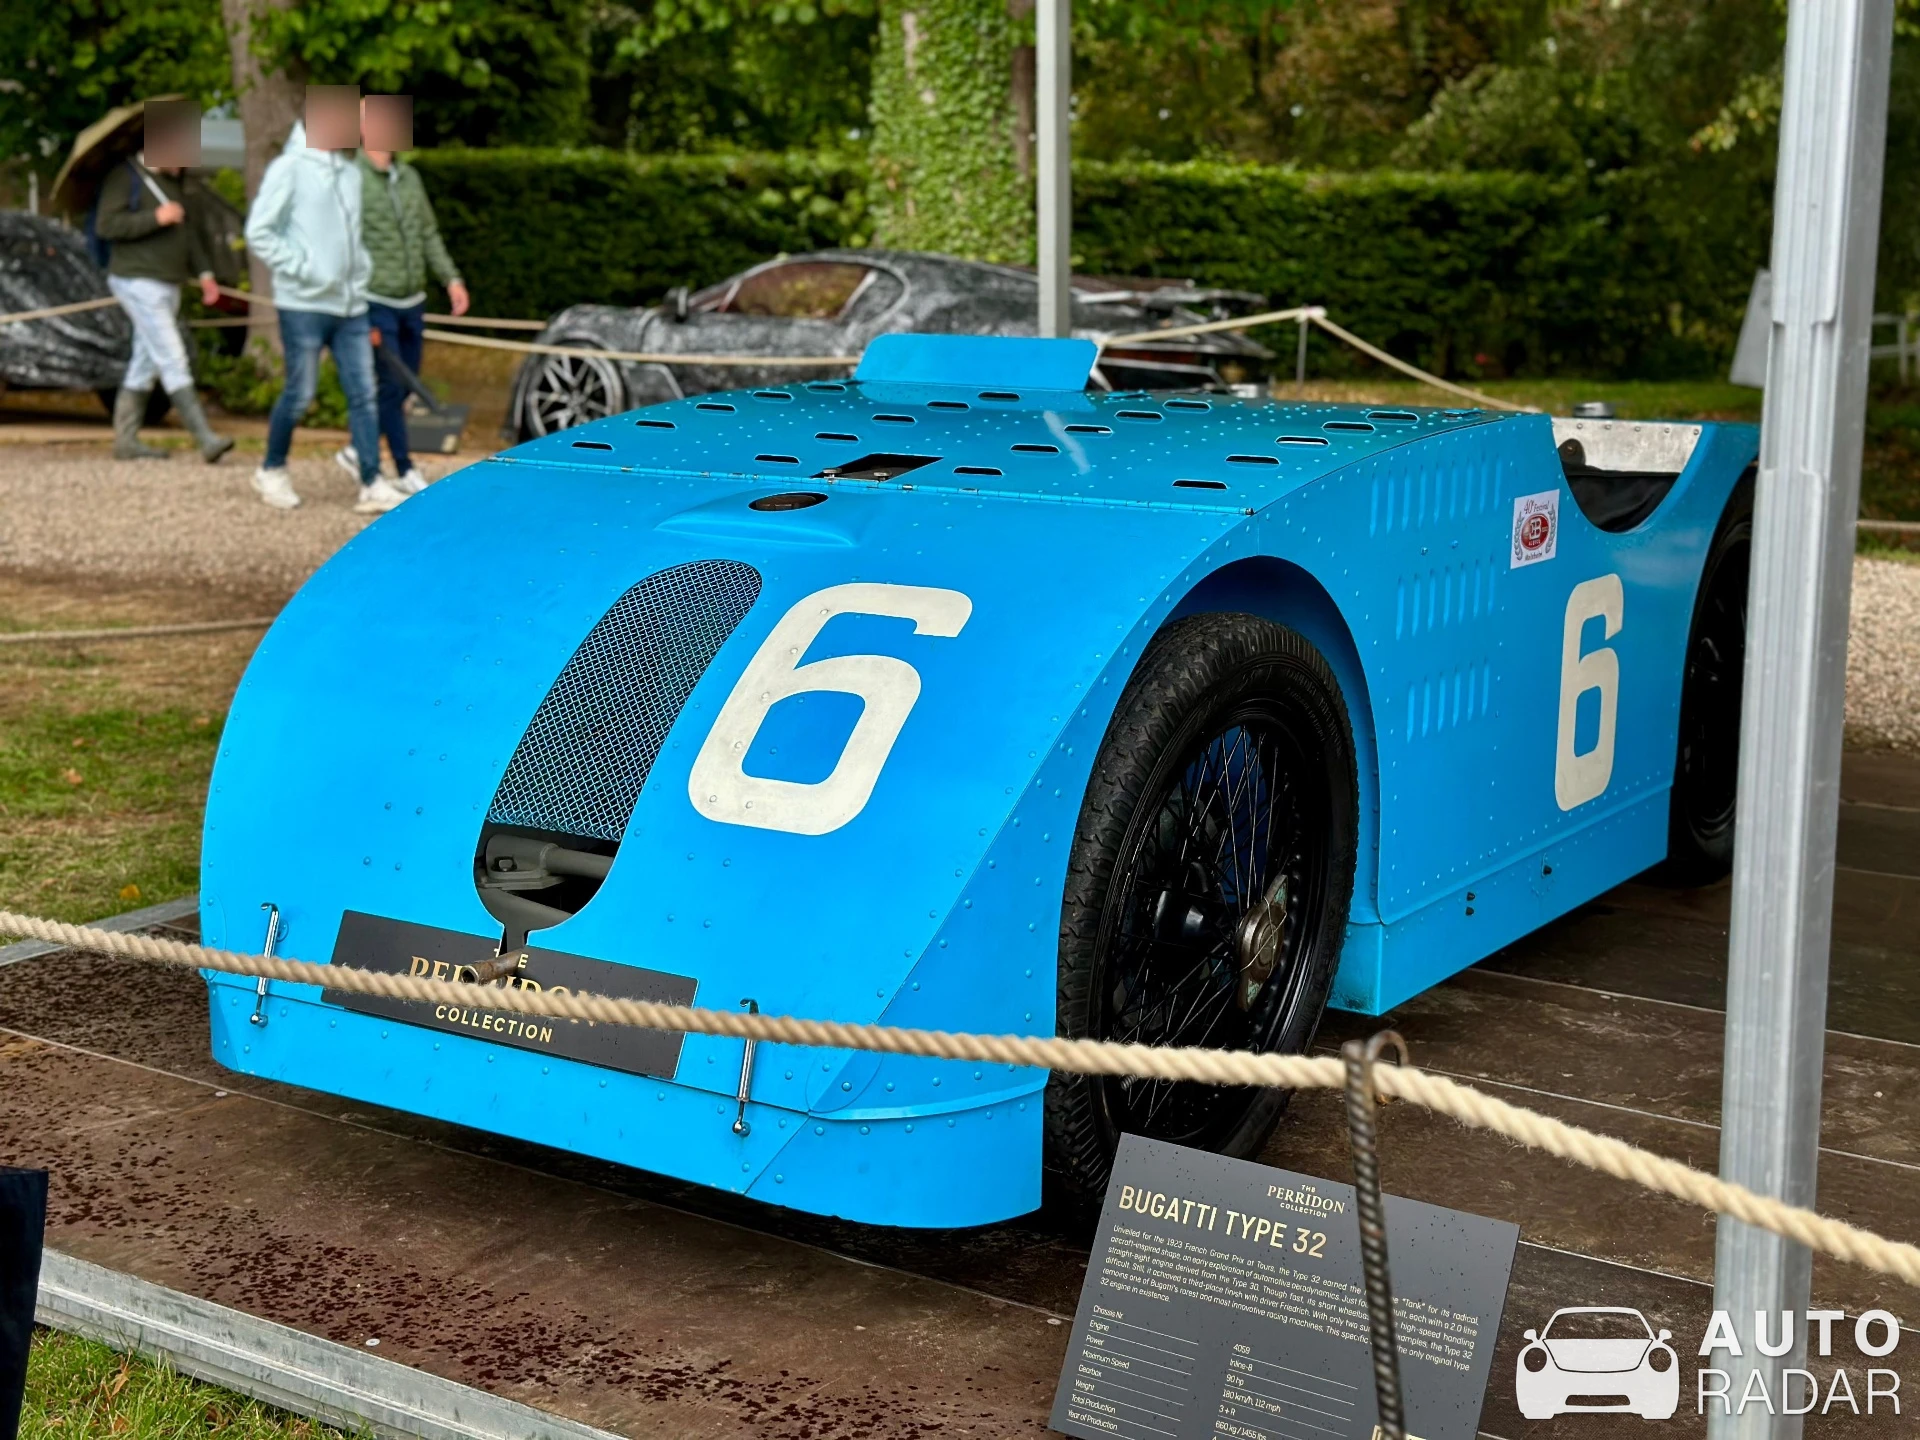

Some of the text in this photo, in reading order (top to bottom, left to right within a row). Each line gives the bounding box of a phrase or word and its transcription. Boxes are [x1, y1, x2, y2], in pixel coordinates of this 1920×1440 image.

[1555, 573, 1624, 811] 6
[688, 582, 973, 836] 6
[494, 948, 529, 969] TE
[435, 1005, 553, 1043] COLLECTION
[1301, 1184, 1316, 1193] THE
[1267, 1185, 1346, 1214] PERRIDON
[1280, 1202, 1327, 1219] COLLECTION
[1118, 1185, 1327, 1258] BUGATTI TYPE 32
[1114, 1225, 1140, 1238] Unveiled
[1143, 1232, 1152, 1240] for
[1154, 1235, 1164, 1243] the
[1167, 1238, 1183, 1248] 1923
[1185, 1243, 1208, 1254] French
[1210, 1249, 1229, 1260] Grand
[1232, 1255, 1244, 1264] Prix
[1279, 1267, 1290, 1276] the
[1293, 1270, 1308, 1281] Type
[1311, 1275, 1320, 1283] 32
[1323, 1280, 1347, 1290] earned
[1350, 1286, 1361, 1295] the
[1428, 1305, 1438, 1314] for
[1441, 1308, 1450, 1317] its
[1100, 1277, 1109, 1286] 32
[1110, 1279, 1131, 1291] engine
[1132, 1286, 1138, 1294] in
[1108, 1247, 1150, 1262] straight-eight
[1152, 1258, 1173, 1269] engine
[1176, 1264, 1199, 1276] derived
[1201, 1270, 1216, 1280] from
[1219, 1275, 1230, 1283] the
[1232, 1277, 1247, 1288] Type
[1263, 1286, 1287, 1299] Though
[1307, 1298, 1316, 1306] its
[1318, 1301, 1336, 1311] short
[1401, 1322, 1441, 1339] high-speed
[1443, 1333, 1475, 1350] handling
[1209, 1262, 1245, 1275] exploration
[1254, 1272, 1290, 1288] automotive
[1342, 1295, 1357, 1305] Just
[1409, 1313, 1426, 1324] each
[1428, 1317, 1443, 1327] with
[1463, 1328, 1477, 1336] litre
[1093, 1305, 1115, 1318] Chassis
[1103, 1268, 1128, 1279] remains
[1180, 1288, 1198, 1298] rarest
[1200, 1293, 1212, 1302] and
[1214, 1297, 1231, 1307] most
[1231, 1302, 1265, 1316] innovative
[1267, 1311, 1287, 1324] racing
[1326, 1326, 1340, 1336] This
[1341, 1331, 1368, 1344] specific
[1409, 1349, 1425, 1360] only
[1426, 1354, 1452, 1367] original
[1454, 1360, 1469, 1371] type
[1153, 1269, 1181, 1282] achieved
[1189, 1278, 1223, 1294] third-place
[1225, 1287, 1242, 1298] finish
[1245, 1292, 1258, 1302] with
[1260, 1297, 1279, 1308] driver
[1313, 1310, 1327, 1320] With
[1330, 1316, 1344, 1326] only
[1345, 1321, 1357, 1329] two
[1430, 1342, 1442, 1352] the
[1444, 1345, 1460, 1357] Type
[1462, 1350, 1472, 1360] 32
[1090, 1320, 1109, 1332] Engine
[1086, 1335, 1104, 1346] Power
[1233, 1344, 1250, 1354] 4059
[1079, 1364, 1102, 1377] Gearbox
[1111, 1357, 1130, 1369] Speed
[1230, 1359, 1253, 1371] Inline-8
[1076, 1379, 1094, 1391] Weight
[1226, 1374, 1244, 1386] 90 hp
[1072, 1394, 1116, 1414] Total Production
[1219, 1405, 1224, 1413] 3
[1230, 1408, 1236, 1416] R
[1223, 1389, 1234, 1399] 180
[1255, 1399, 1265, 1409] 112
[1266, 1402, 1281, 1413] mph
[1068, 1409, 1117, 1430] Year of Production
[1215, 1420, 1228, 1430] 660
[1229, 1424, 1237, 1435] kg
[1241, 1428, 1256, 1439] 1455
